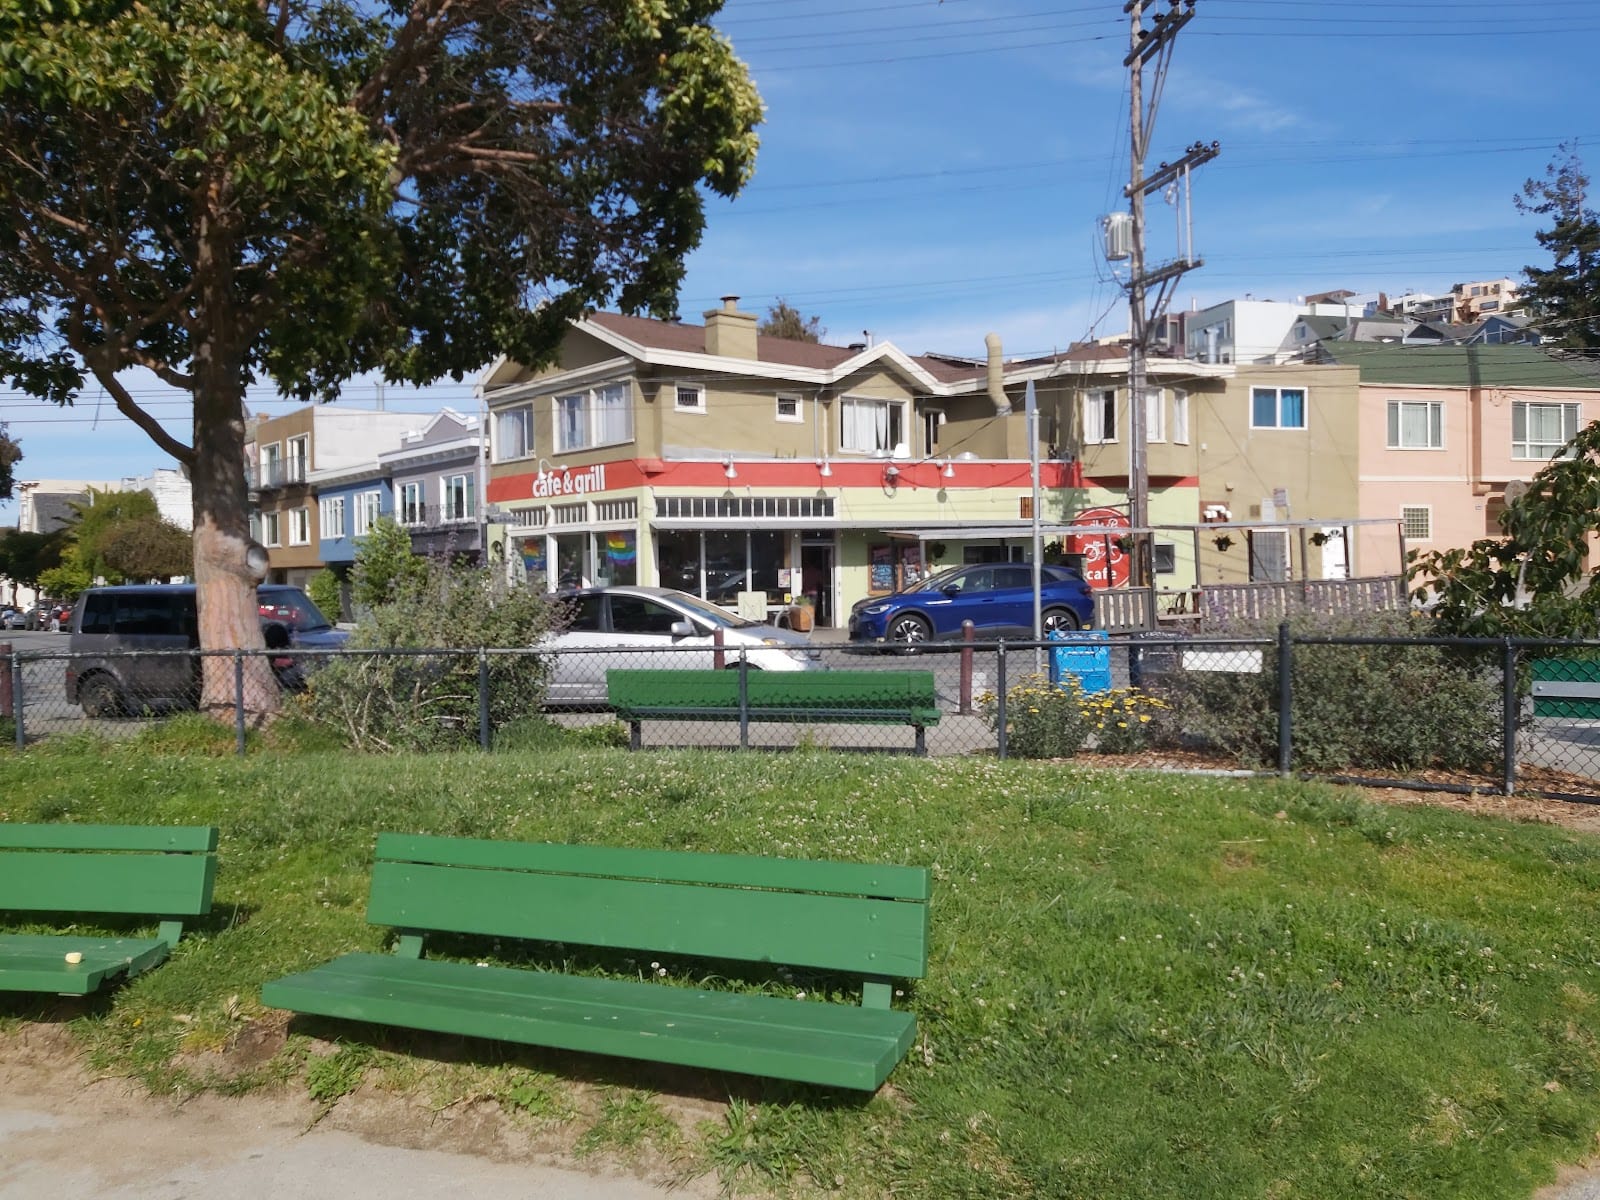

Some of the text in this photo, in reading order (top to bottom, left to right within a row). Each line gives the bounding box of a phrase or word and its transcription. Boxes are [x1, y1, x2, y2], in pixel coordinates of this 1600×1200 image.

[532, 464, 606, 500] cafe & grill
